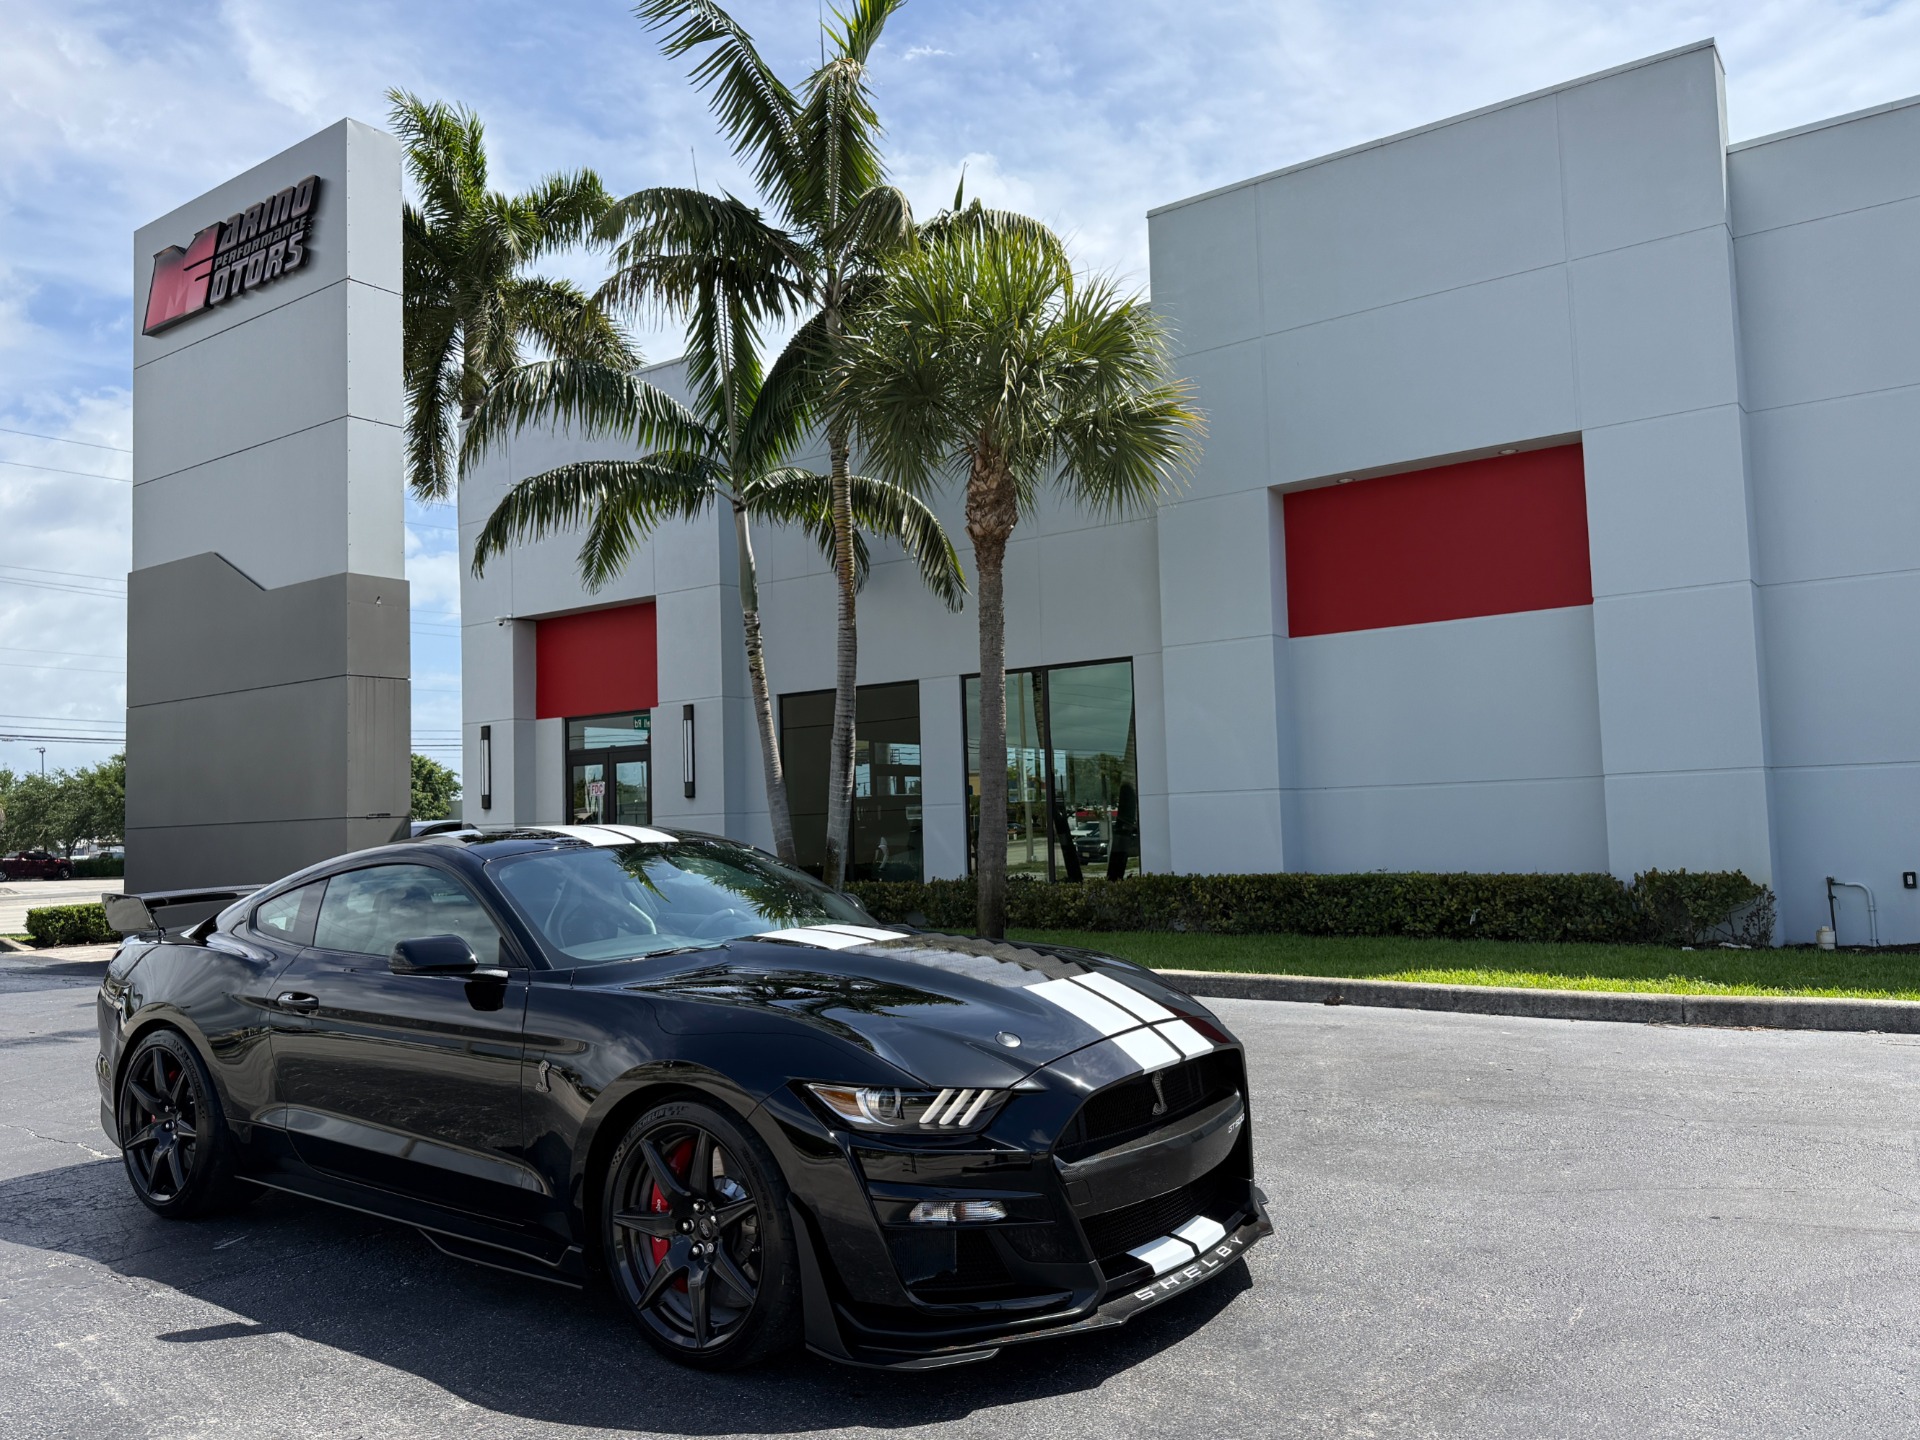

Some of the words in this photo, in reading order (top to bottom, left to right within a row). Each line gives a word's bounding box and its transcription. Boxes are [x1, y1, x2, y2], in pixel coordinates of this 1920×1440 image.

[214, 215, 308, 270] PERFORMANCE
[591, 784, 603, 795] FDC
[1134, 1236, 1243, 1300] SHELBY
